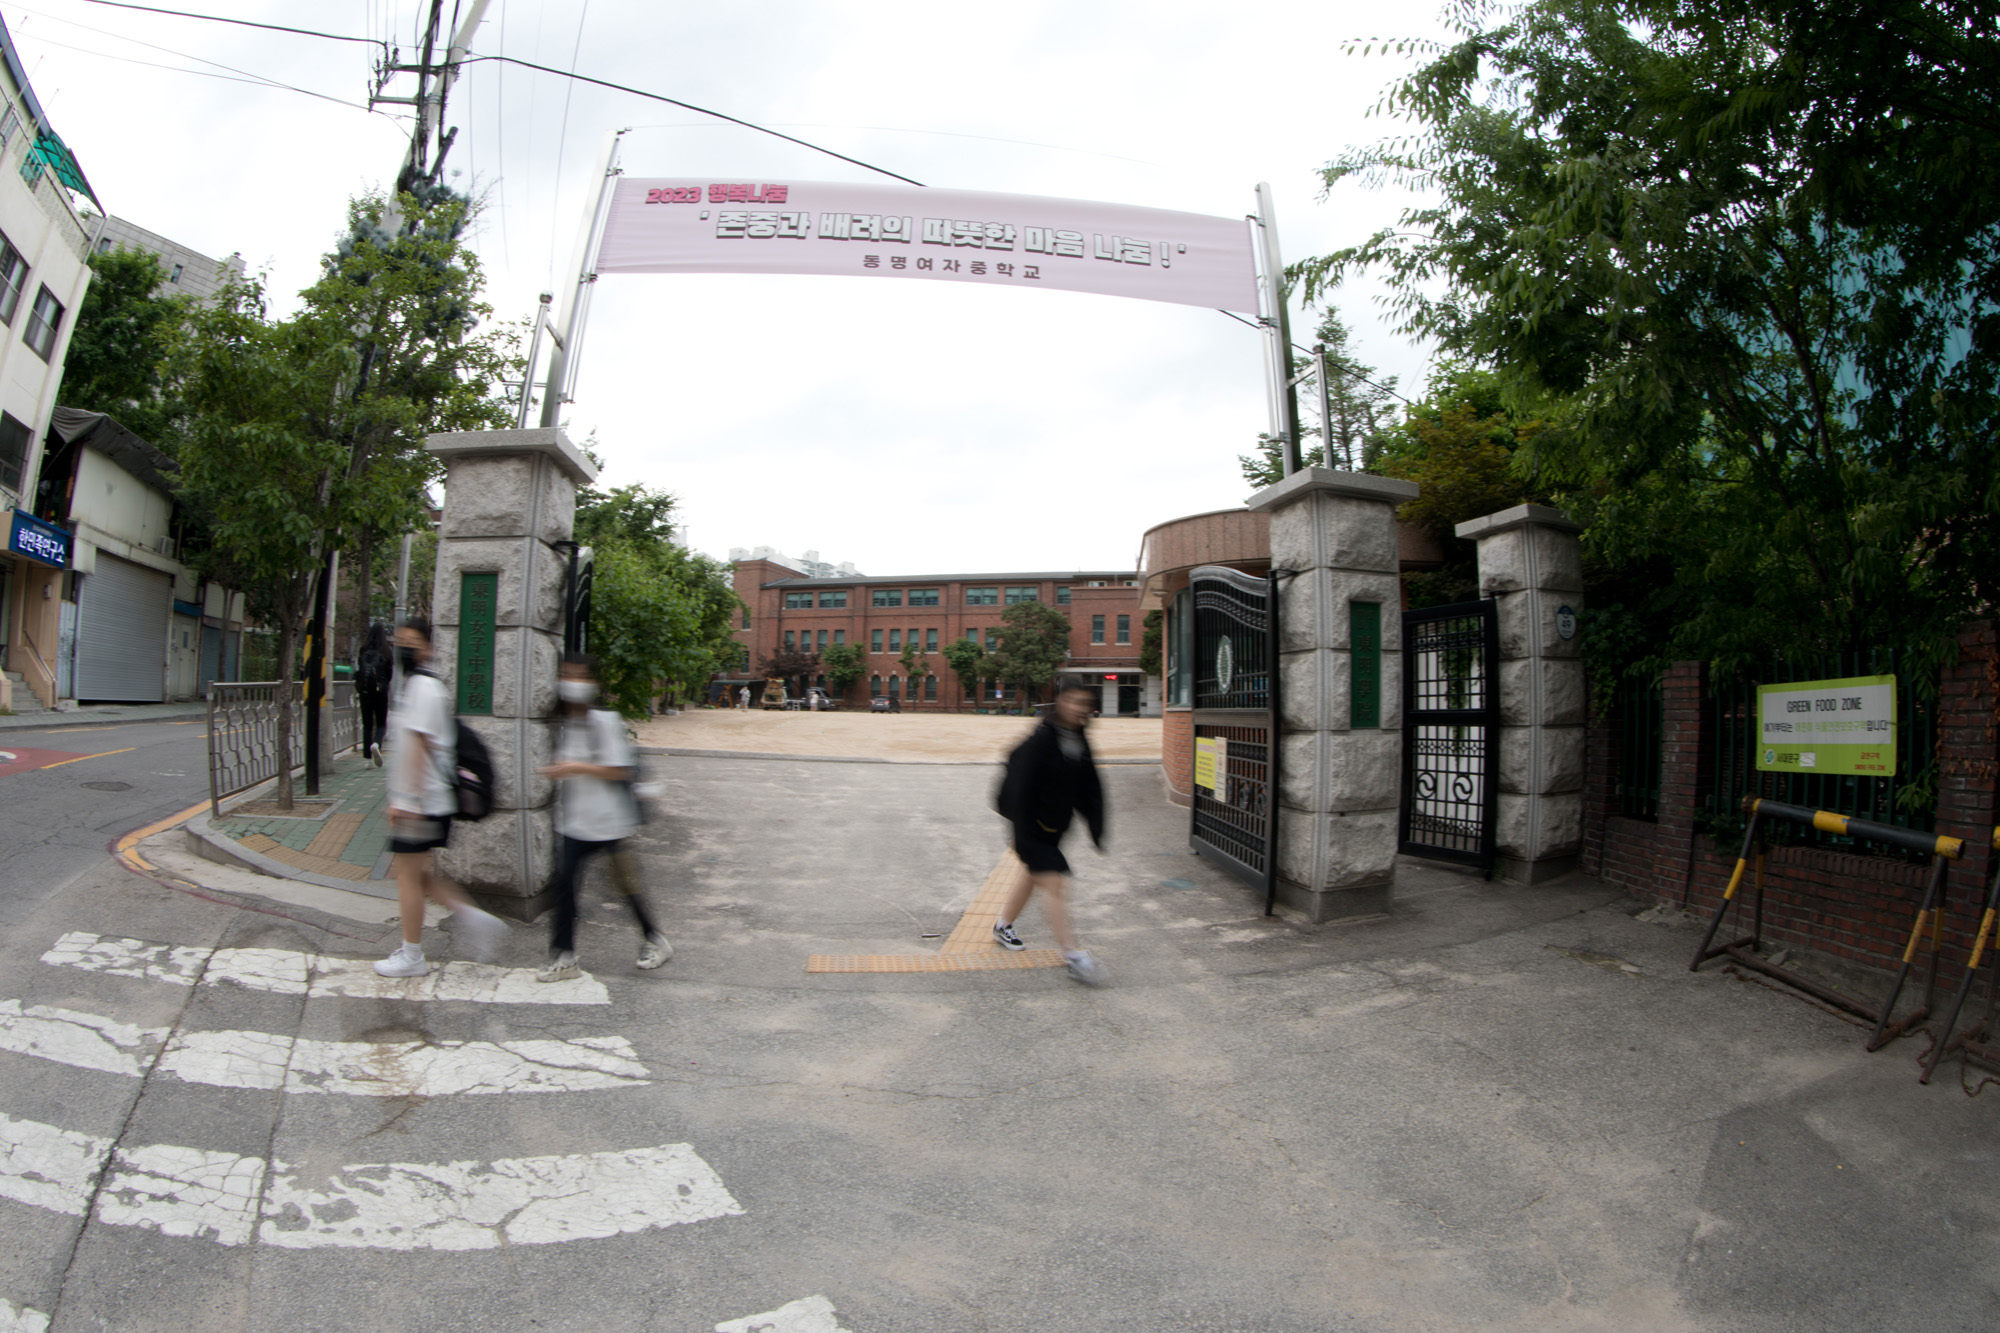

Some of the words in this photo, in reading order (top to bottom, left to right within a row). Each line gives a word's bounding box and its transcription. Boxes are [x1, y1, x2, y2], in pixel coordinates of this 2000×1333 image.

[645, 187, 702, 204] 2023
[708, 184, 788, 204] 행복나눔
[818, 213, 912, 243] 배려의
[922, 217, 1016, 251] 따뜻한
[1024, 226, 1085, 258] 마음
[18, 528, 65, 563] 한민족연구소
[1787, 700, 1811, 713] GREEN
[1815, 699, 1837, 712] FOOD
[1841, 697, 1862, 711] ZONE
